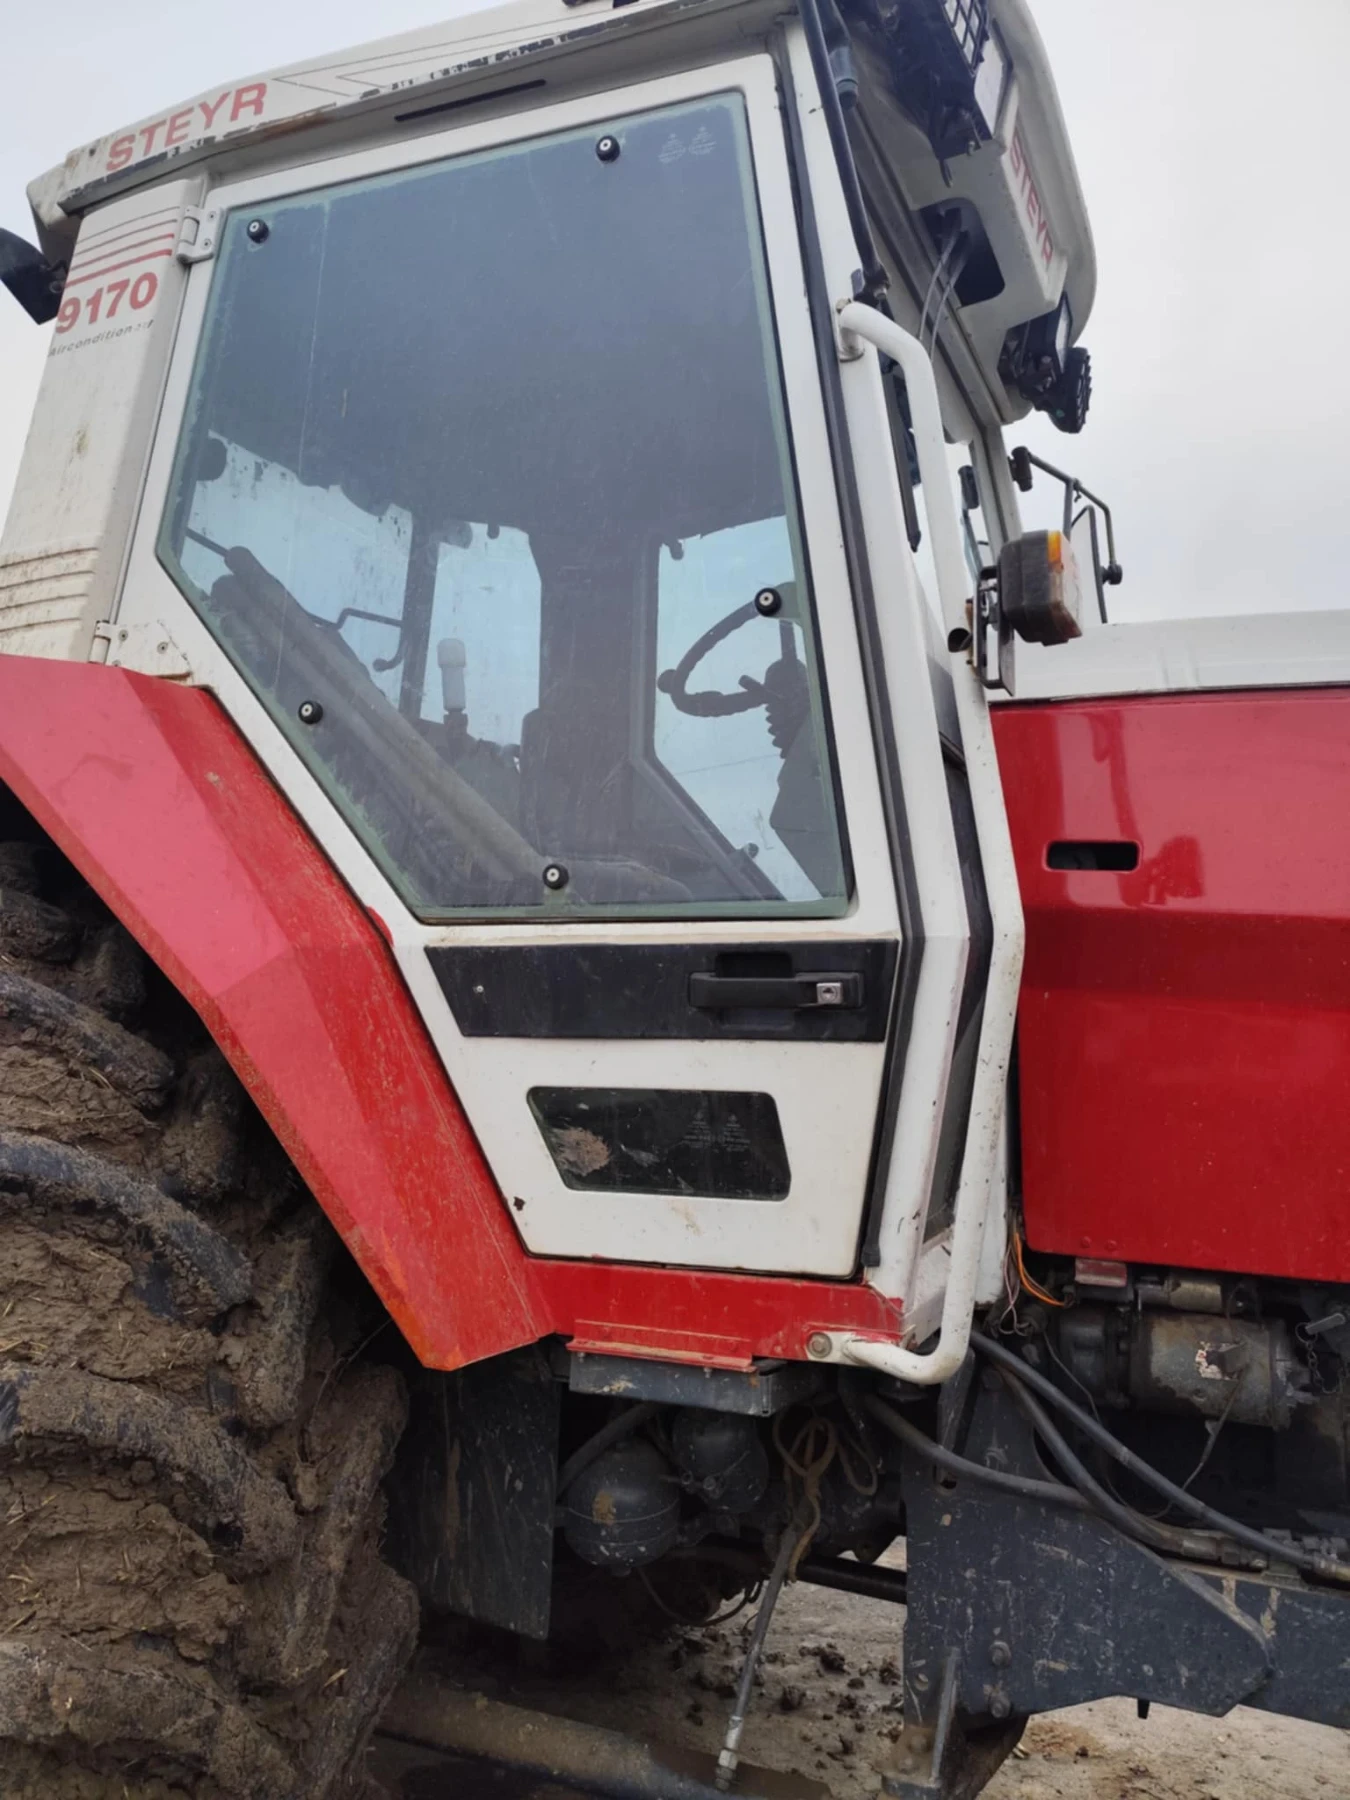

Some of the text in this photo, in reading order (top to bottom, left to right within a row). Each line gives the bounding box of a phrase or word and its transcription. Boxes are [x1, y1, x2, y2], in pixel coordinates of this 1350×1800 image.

[106, 82, 267, 172] STEYR
[1010, 127, 1053, 271] STEYR
[55, 272, 158, 334] 9170
